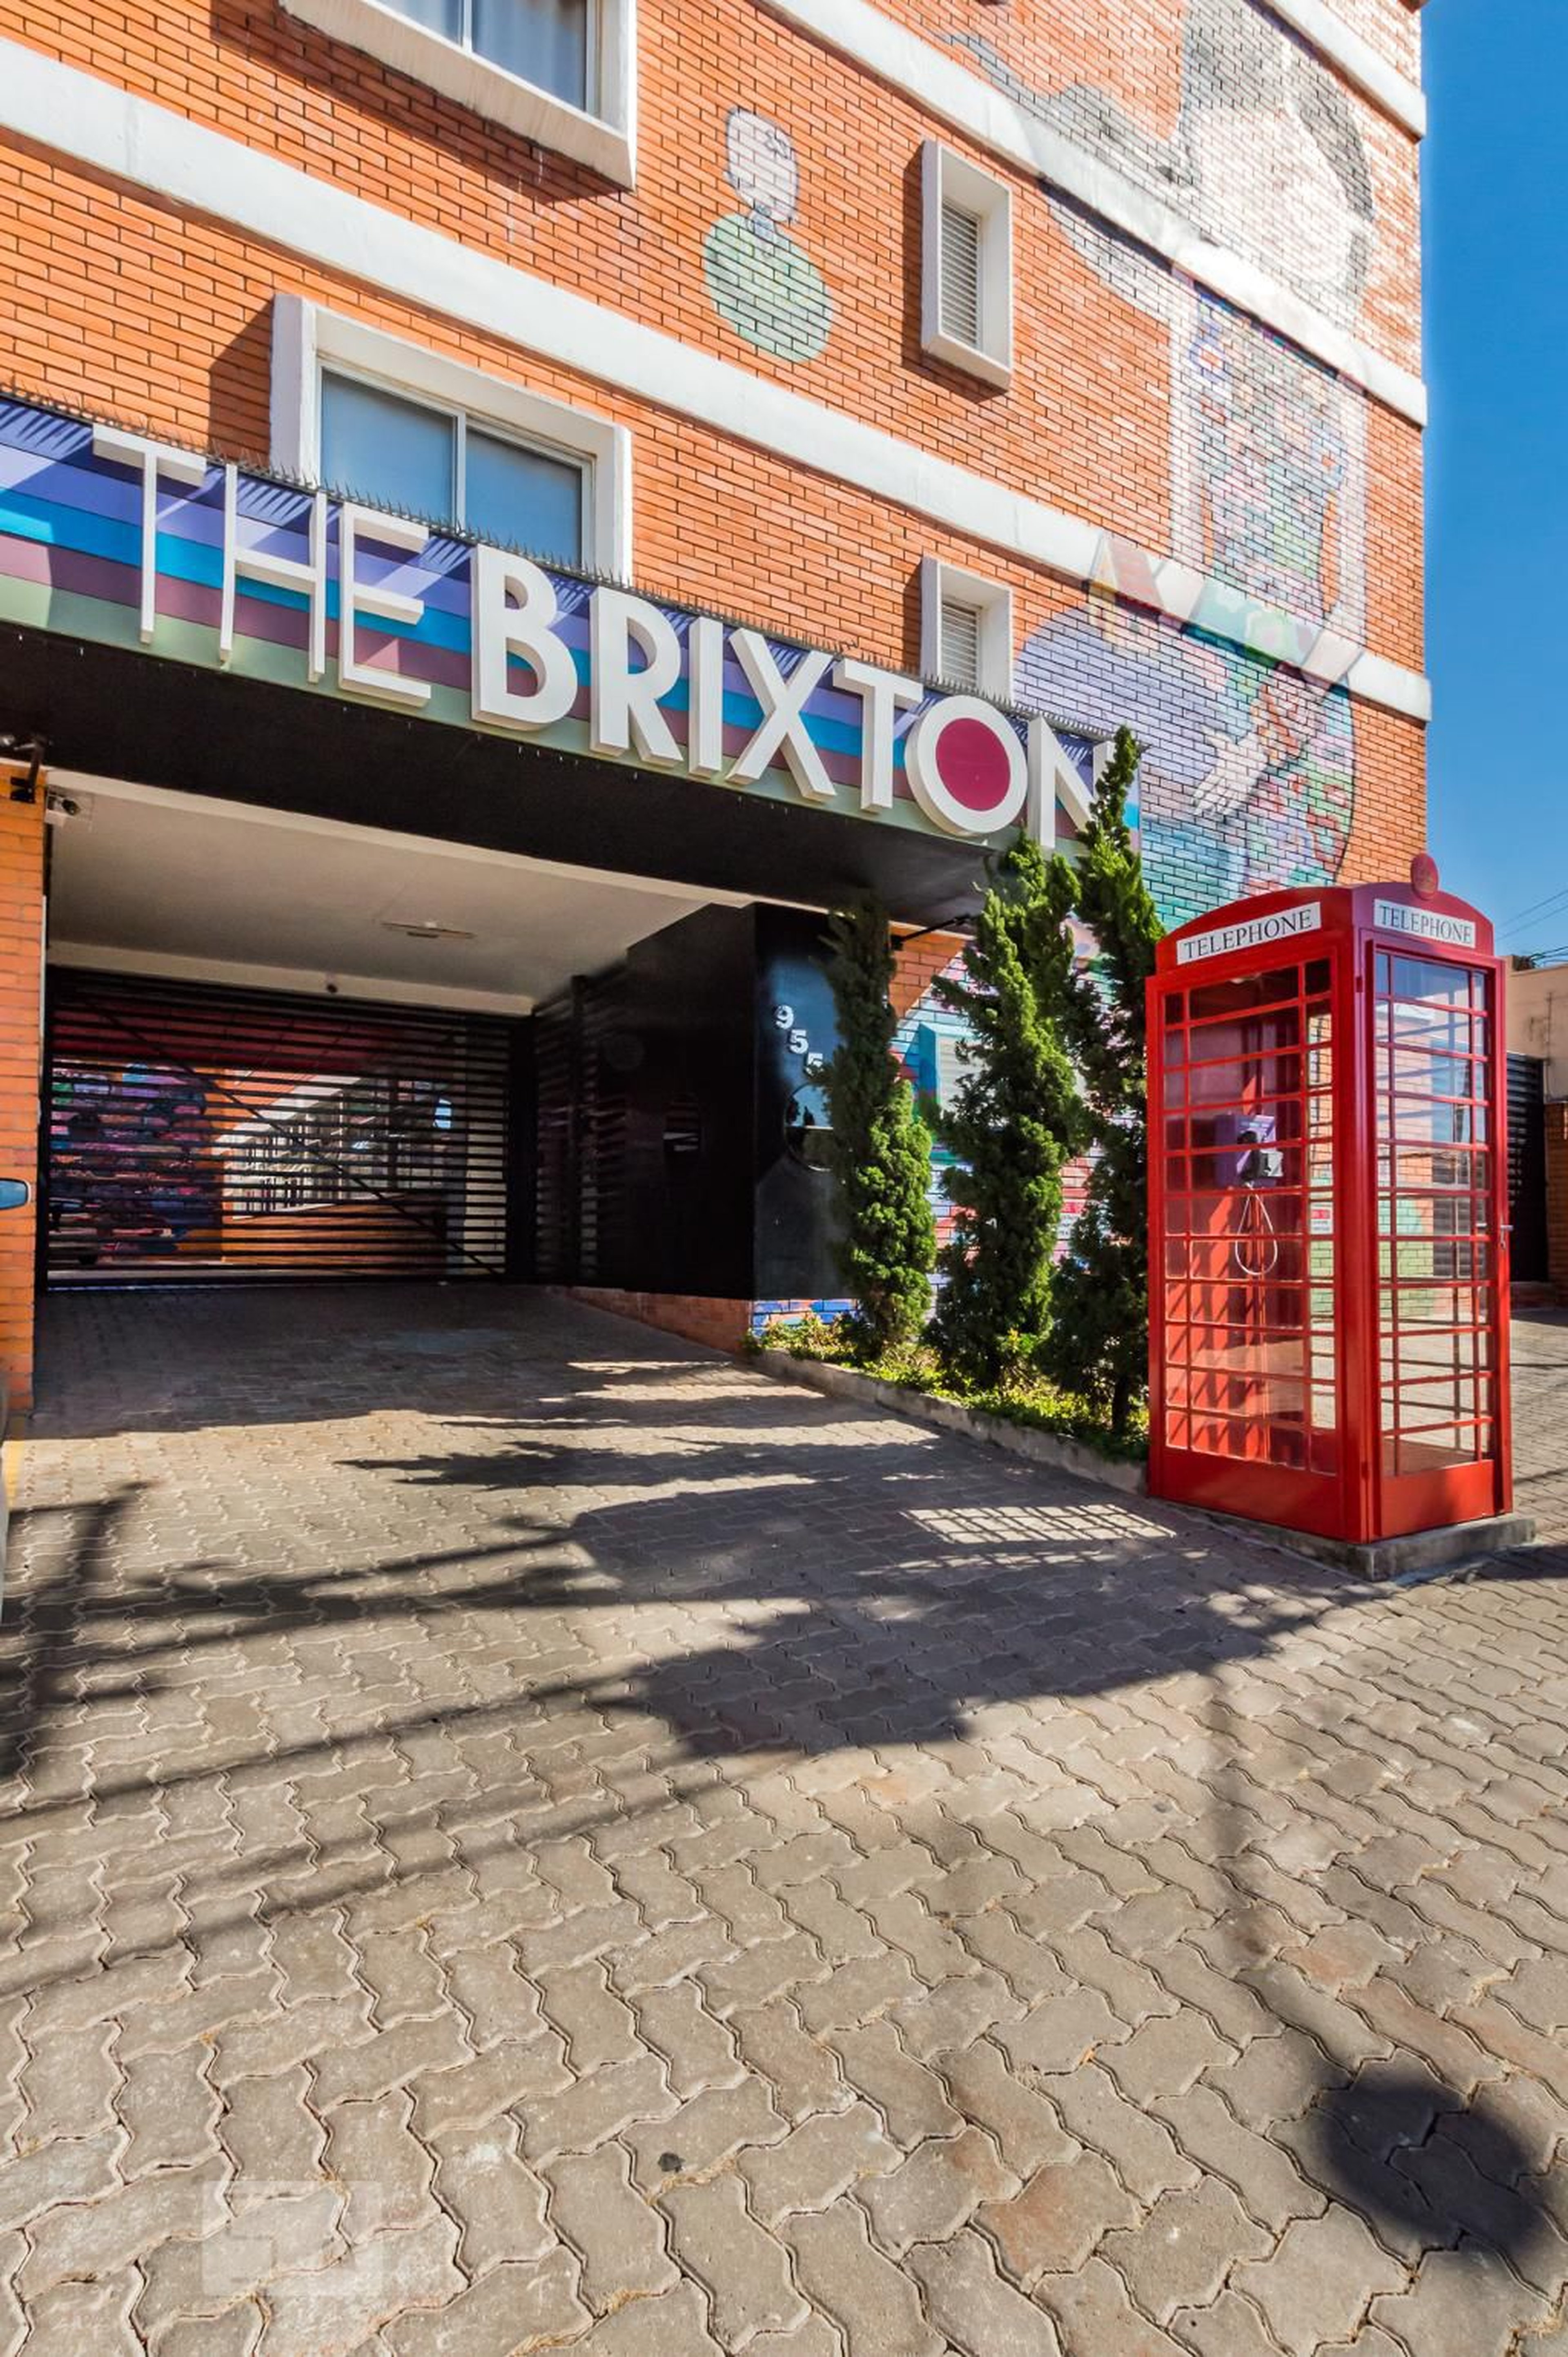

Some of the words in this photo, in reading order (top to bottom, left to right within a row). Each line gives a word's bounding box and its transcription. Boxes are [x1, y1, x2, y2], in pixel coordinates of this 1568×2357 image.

[93, 423, 432, 707] THE
[471, 544, 1116, 849] BRIXTON
[1185, 909, 1312, 959] TELEPHONE
[1379, 905, 1471, 943] TELEPHONE
